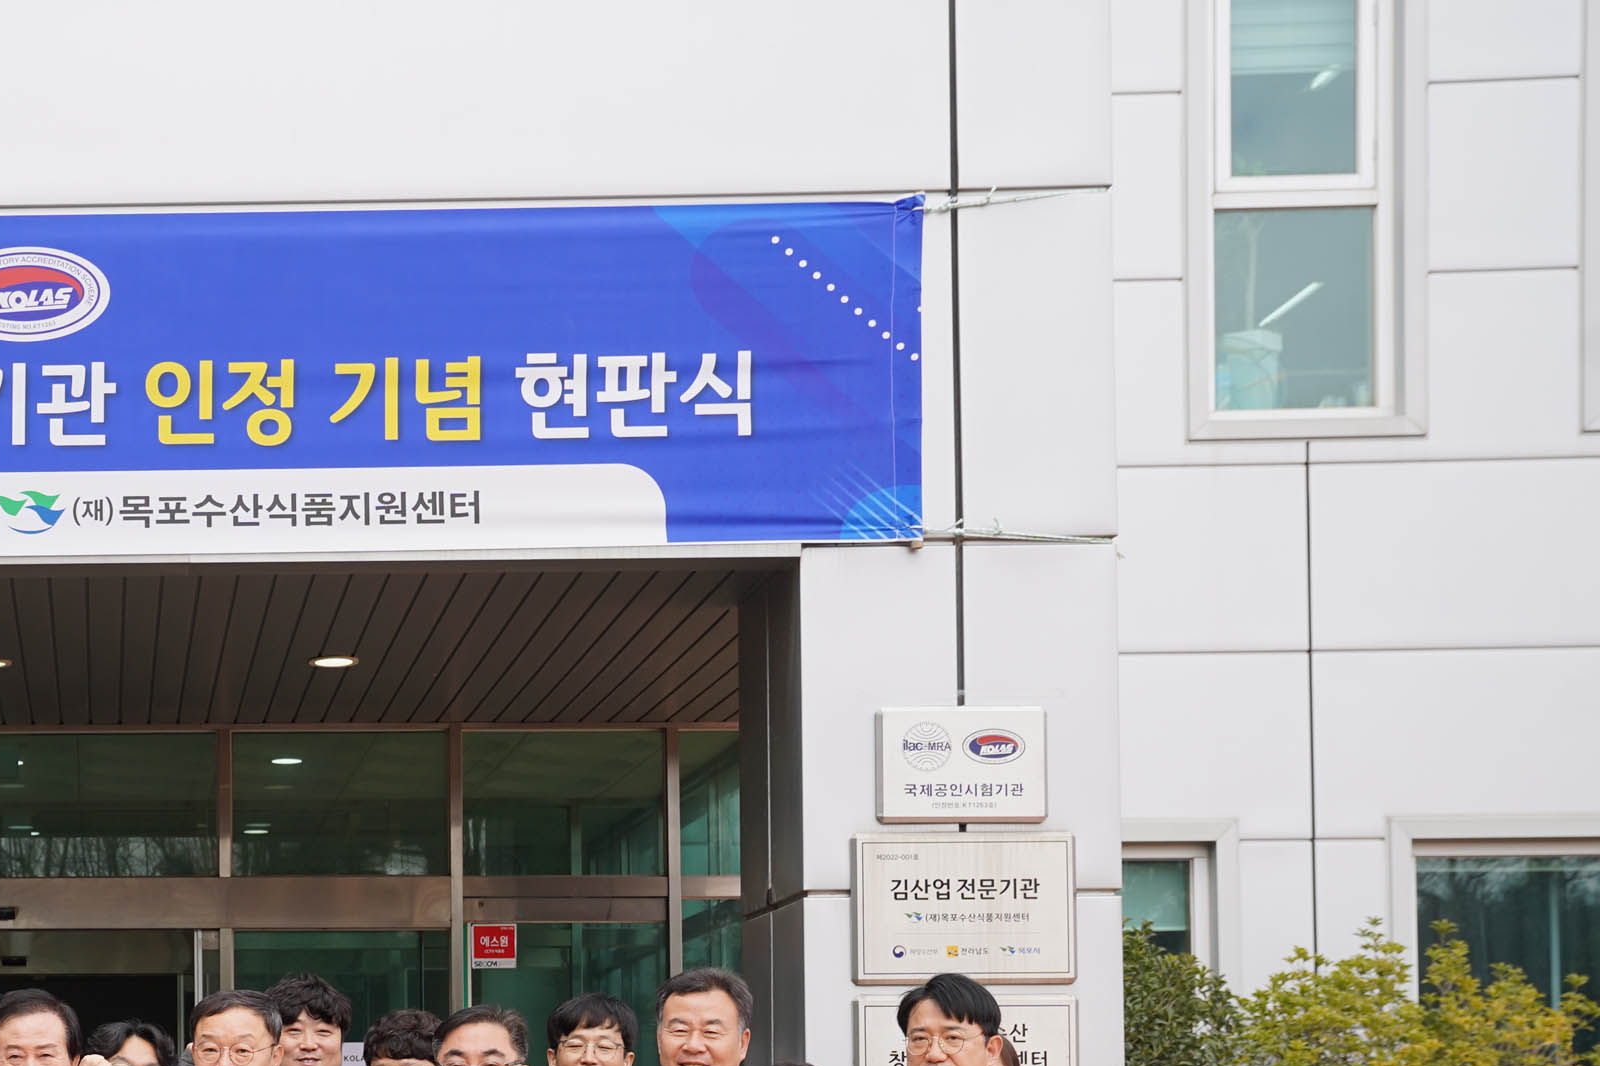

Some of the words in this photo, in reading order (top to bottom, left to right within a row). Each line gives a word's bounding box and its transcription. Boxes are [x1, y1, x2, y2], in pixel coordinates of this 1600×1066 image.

[20, 255, 82, 276] ACCREDITATION
[80, 273, 96, 306] SCHEME
[144, 359, 296, 446] 인정
[329, 355, 483, 442] 기념
[515, 349, 754, 438] 현판식
[903, 739, 952, 752] ilac-MRA
[904, 783, 1024, 797] 국제공인시험기관
[890, 879, 951, 901] 김산업
[956, 877, 1040, 900] 전문기관
[480, 935, 509, 947] 에스원
